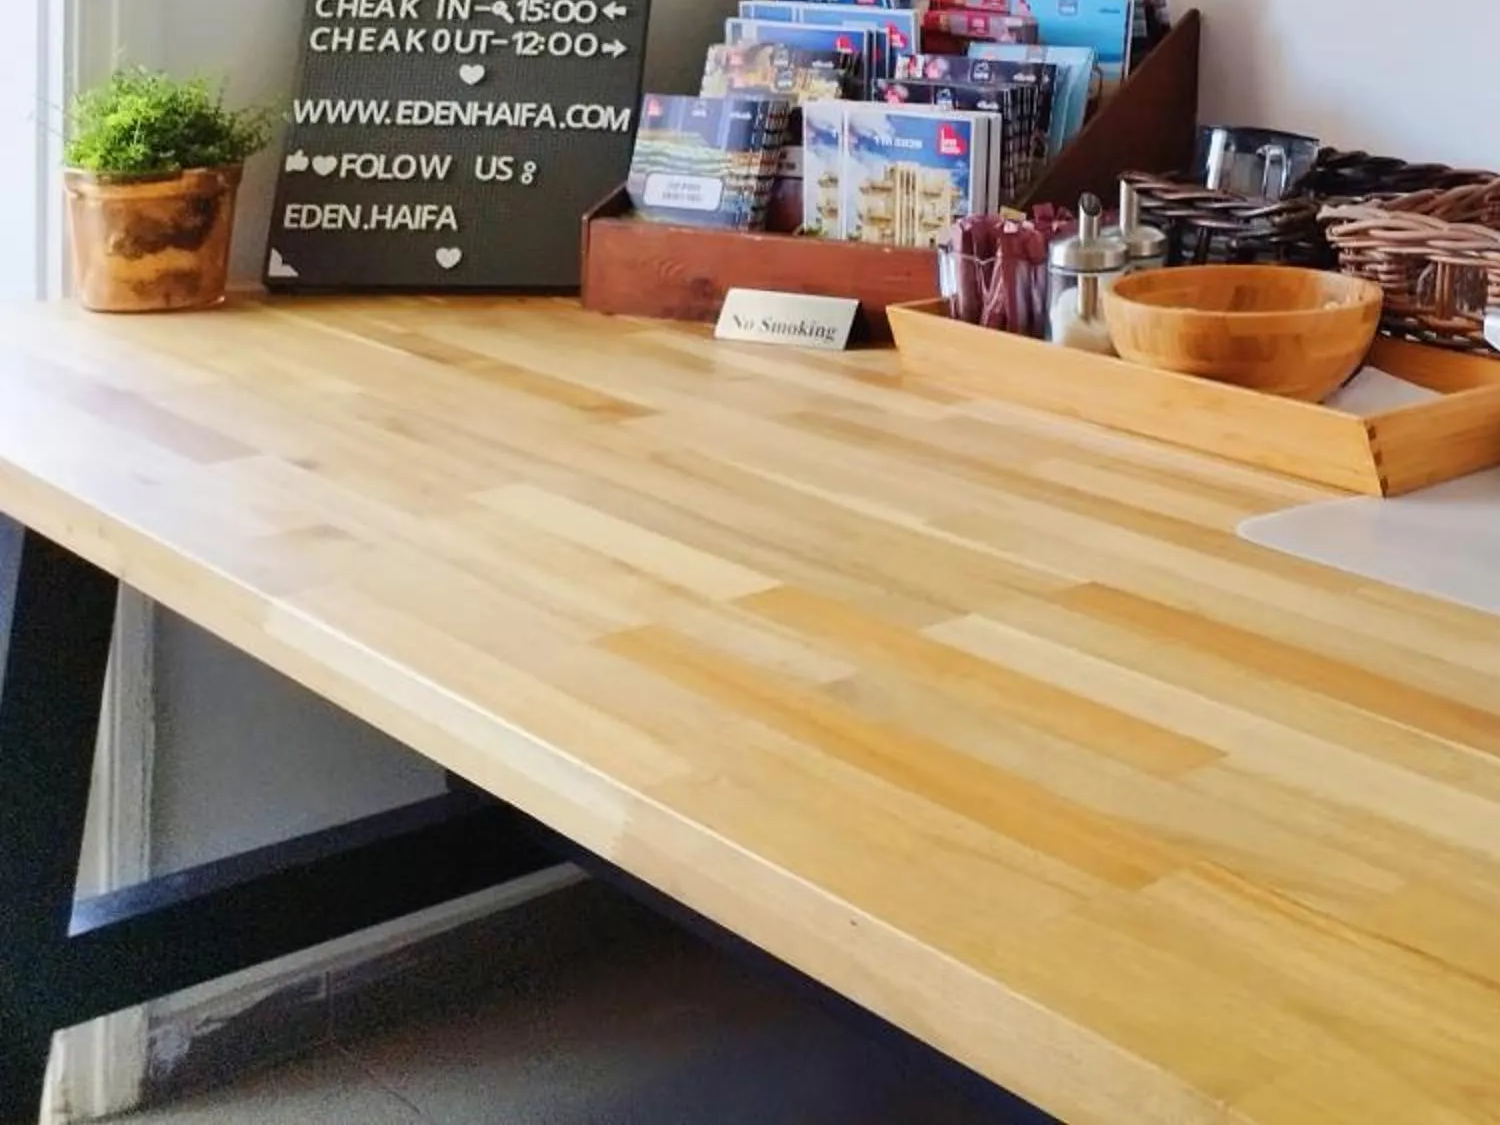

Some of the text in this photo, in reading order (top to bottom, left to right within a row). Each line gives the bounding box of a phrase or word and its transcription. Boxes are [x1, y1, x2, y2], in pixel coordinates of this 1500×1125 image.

[309, 26, 425, 54] CHEAK
[292, 98, 631, 133] WWW.EDENHAIFA.COM
[339, 153, 451, 181] FOLOW
[282, 203, 459, 232] EDEN.HAIFA
[732, 313, 838, 342] No Smoking
